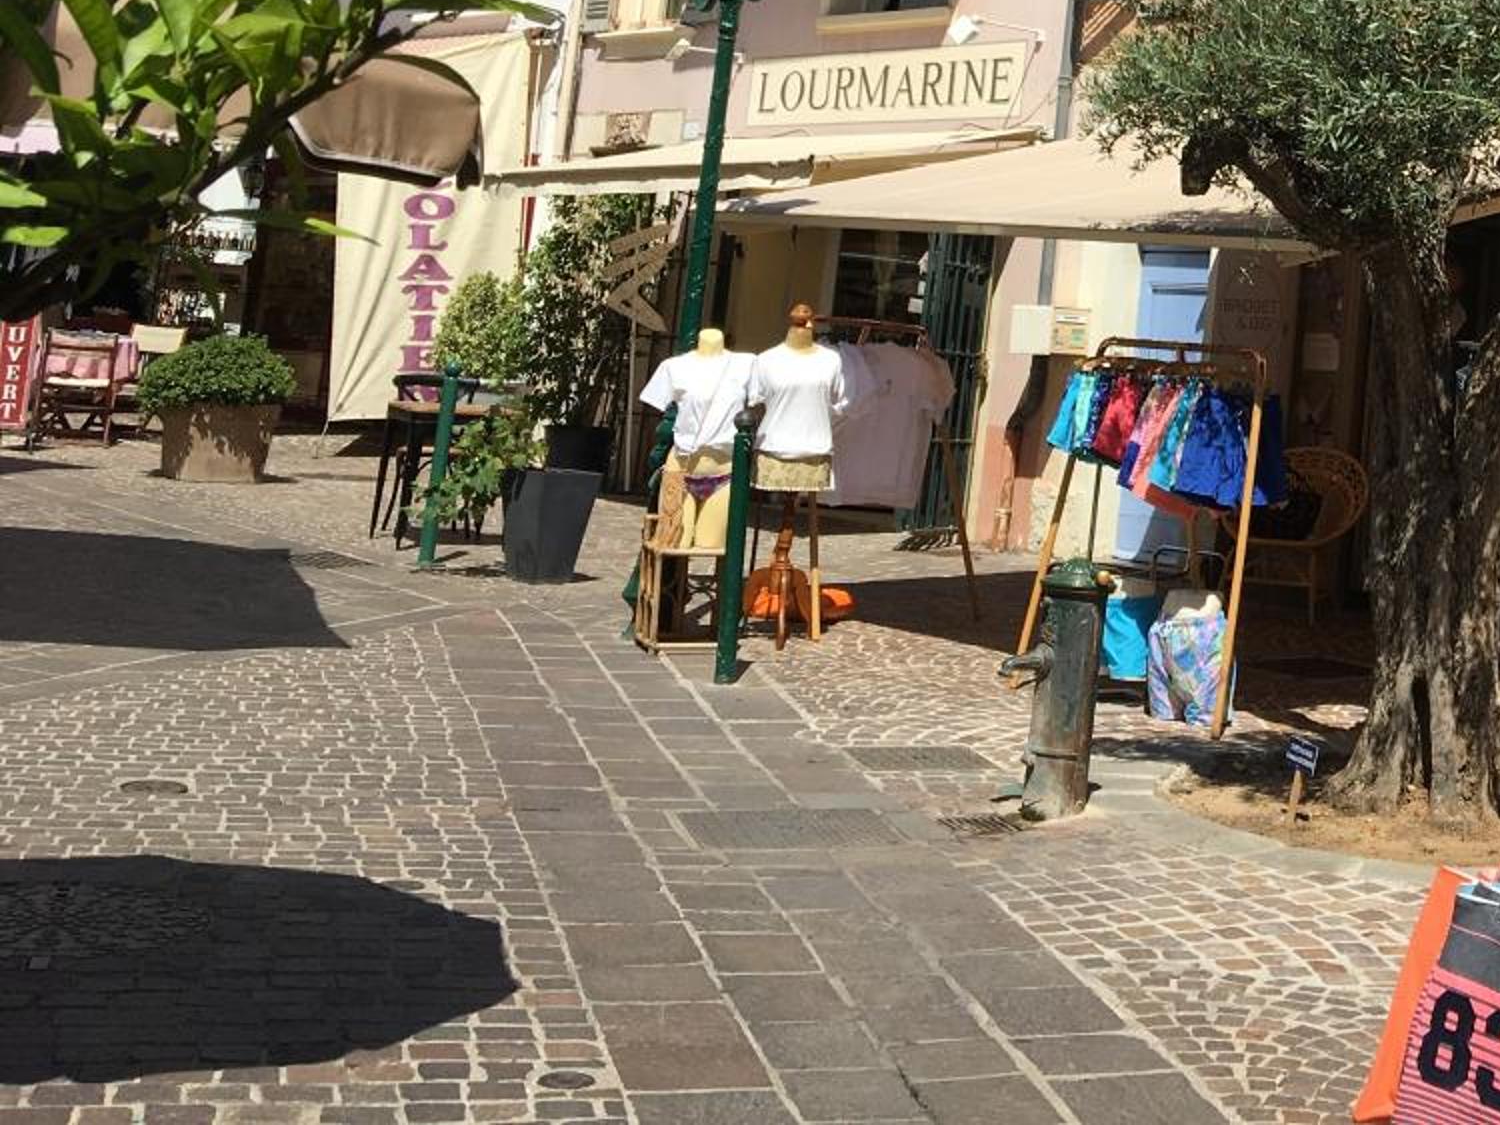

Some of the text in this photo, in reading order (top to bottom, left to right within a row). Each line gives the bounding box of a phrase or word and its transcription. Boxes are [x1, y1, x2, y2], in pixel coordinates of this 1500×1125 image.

[758, 57, 1013, 114] LOURMARINE
[397, 177, 455, 402] OLATIE
[0, 326, 28, 420] UVERT
